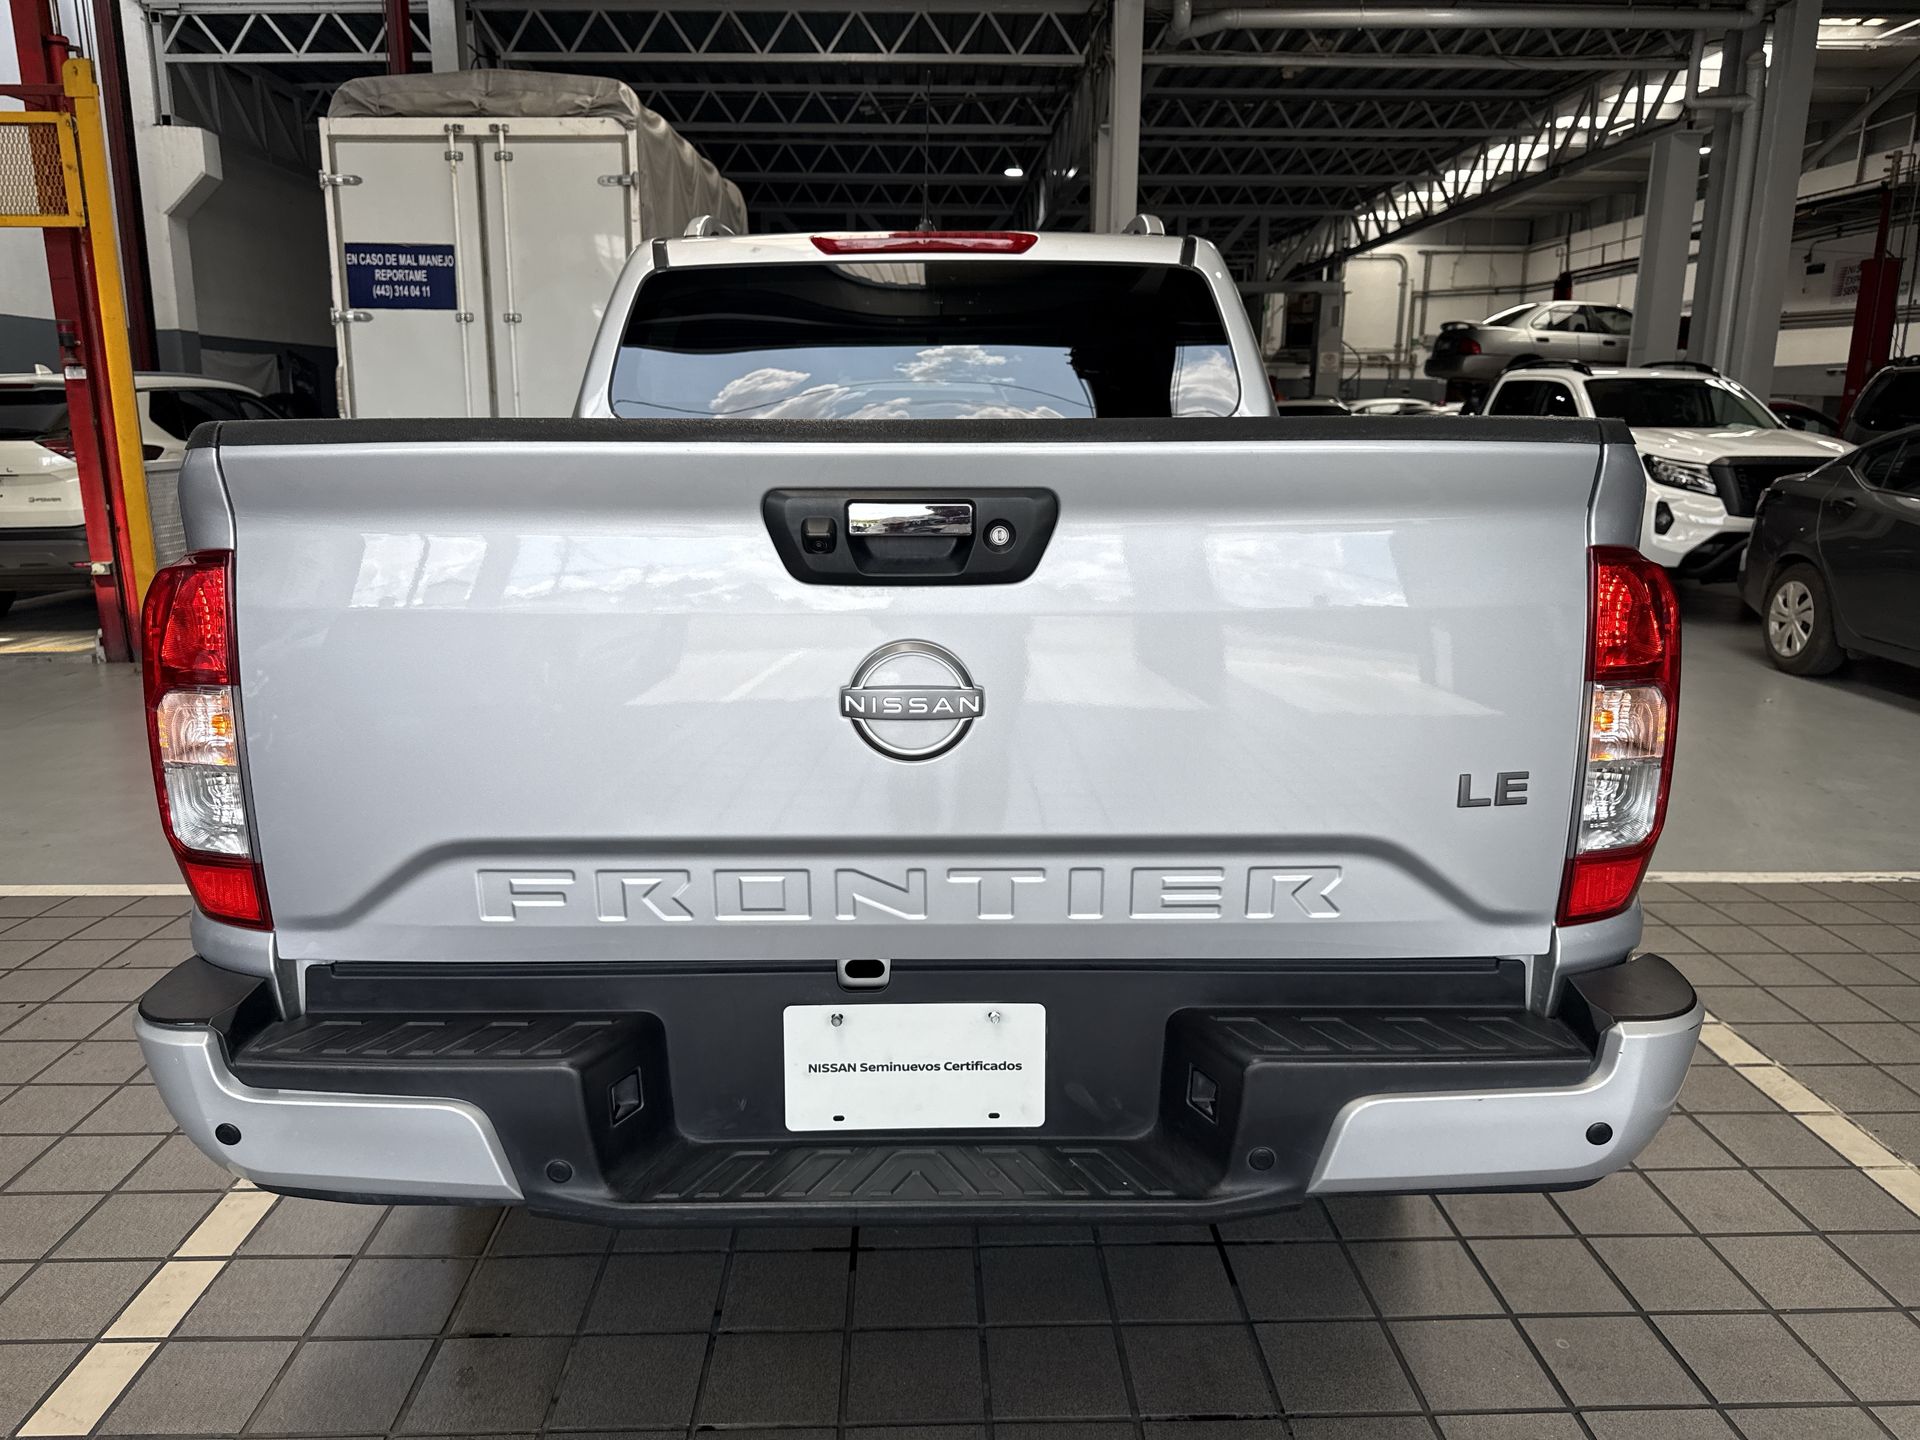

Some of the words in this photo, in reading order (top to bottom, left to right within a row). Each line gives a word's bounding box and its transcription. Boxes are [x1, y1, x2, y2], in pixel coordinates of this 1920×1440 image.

[346, 253, 358, 266] EN
[359, 253, 384, 266] CASO
[385, 253, 398, 266] DE
[398, 254, 418, 267] MAL
[418, 254, 455, 268] MANEJO
[374, 269, 428, 282] REPORTAME
[372, 284, 394, 299] (443)
[394, 285, 409, 298] 314
[422, 285, 431, 298] 11
[844, 695, 980, 714] NISSAN
[1456, 771, 1530, 808] LE
[475, 865, 1343, 922] FRONTIER
[808, 1063, 857, 1074] NISSAN
[859, 1061, 941, 1073] Seminuevos
[943, 1060, 1023, 1072] Certificados
